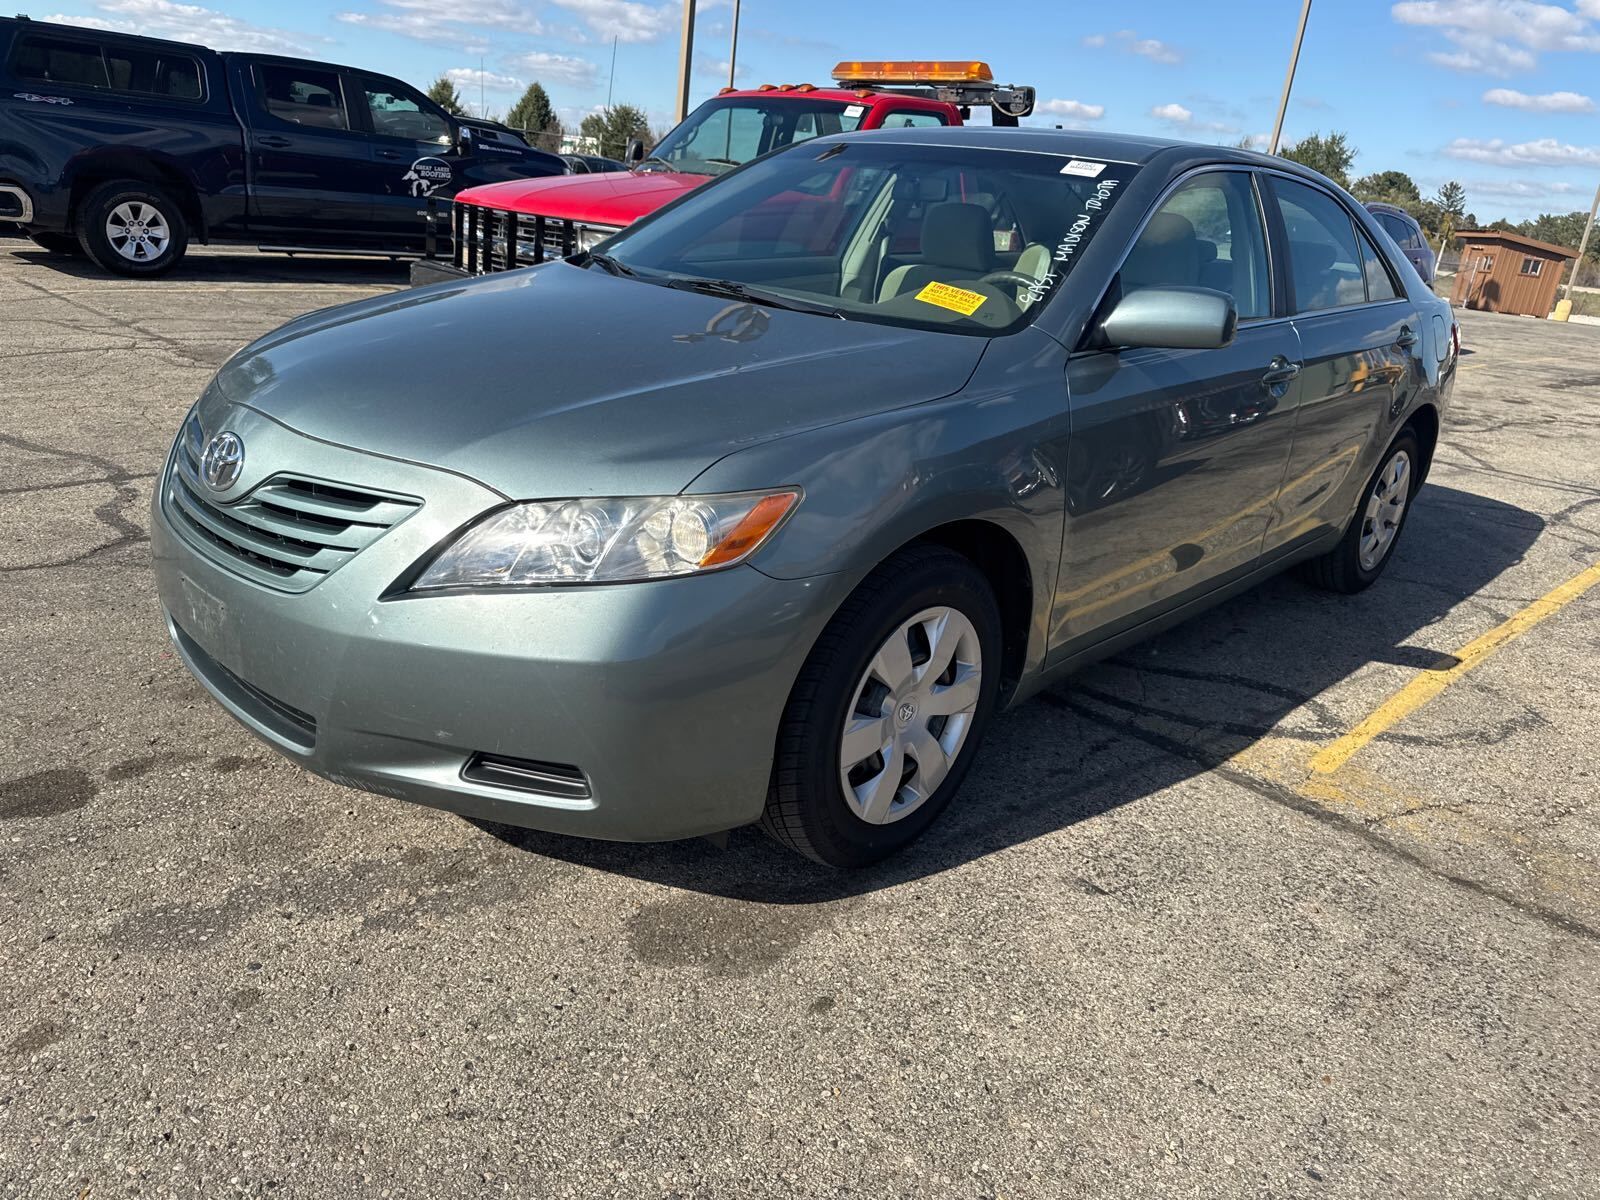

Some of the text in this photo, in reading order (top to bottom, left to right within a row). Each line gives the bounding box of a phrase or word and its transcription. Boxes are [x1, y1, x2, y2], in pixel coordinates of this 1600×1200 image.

[420, 170, 451, 178] ROOFING
[1019, 265, 1058, 302] EAST
[1053, 214, 1091, 262] MADISON
[1085, 179, 1120, 211] TOYOTA
[933, 283, 949, 292] THIS
[951, 288, 983, 302] VEHICLE
[960, 296, 976, 305] SALE
